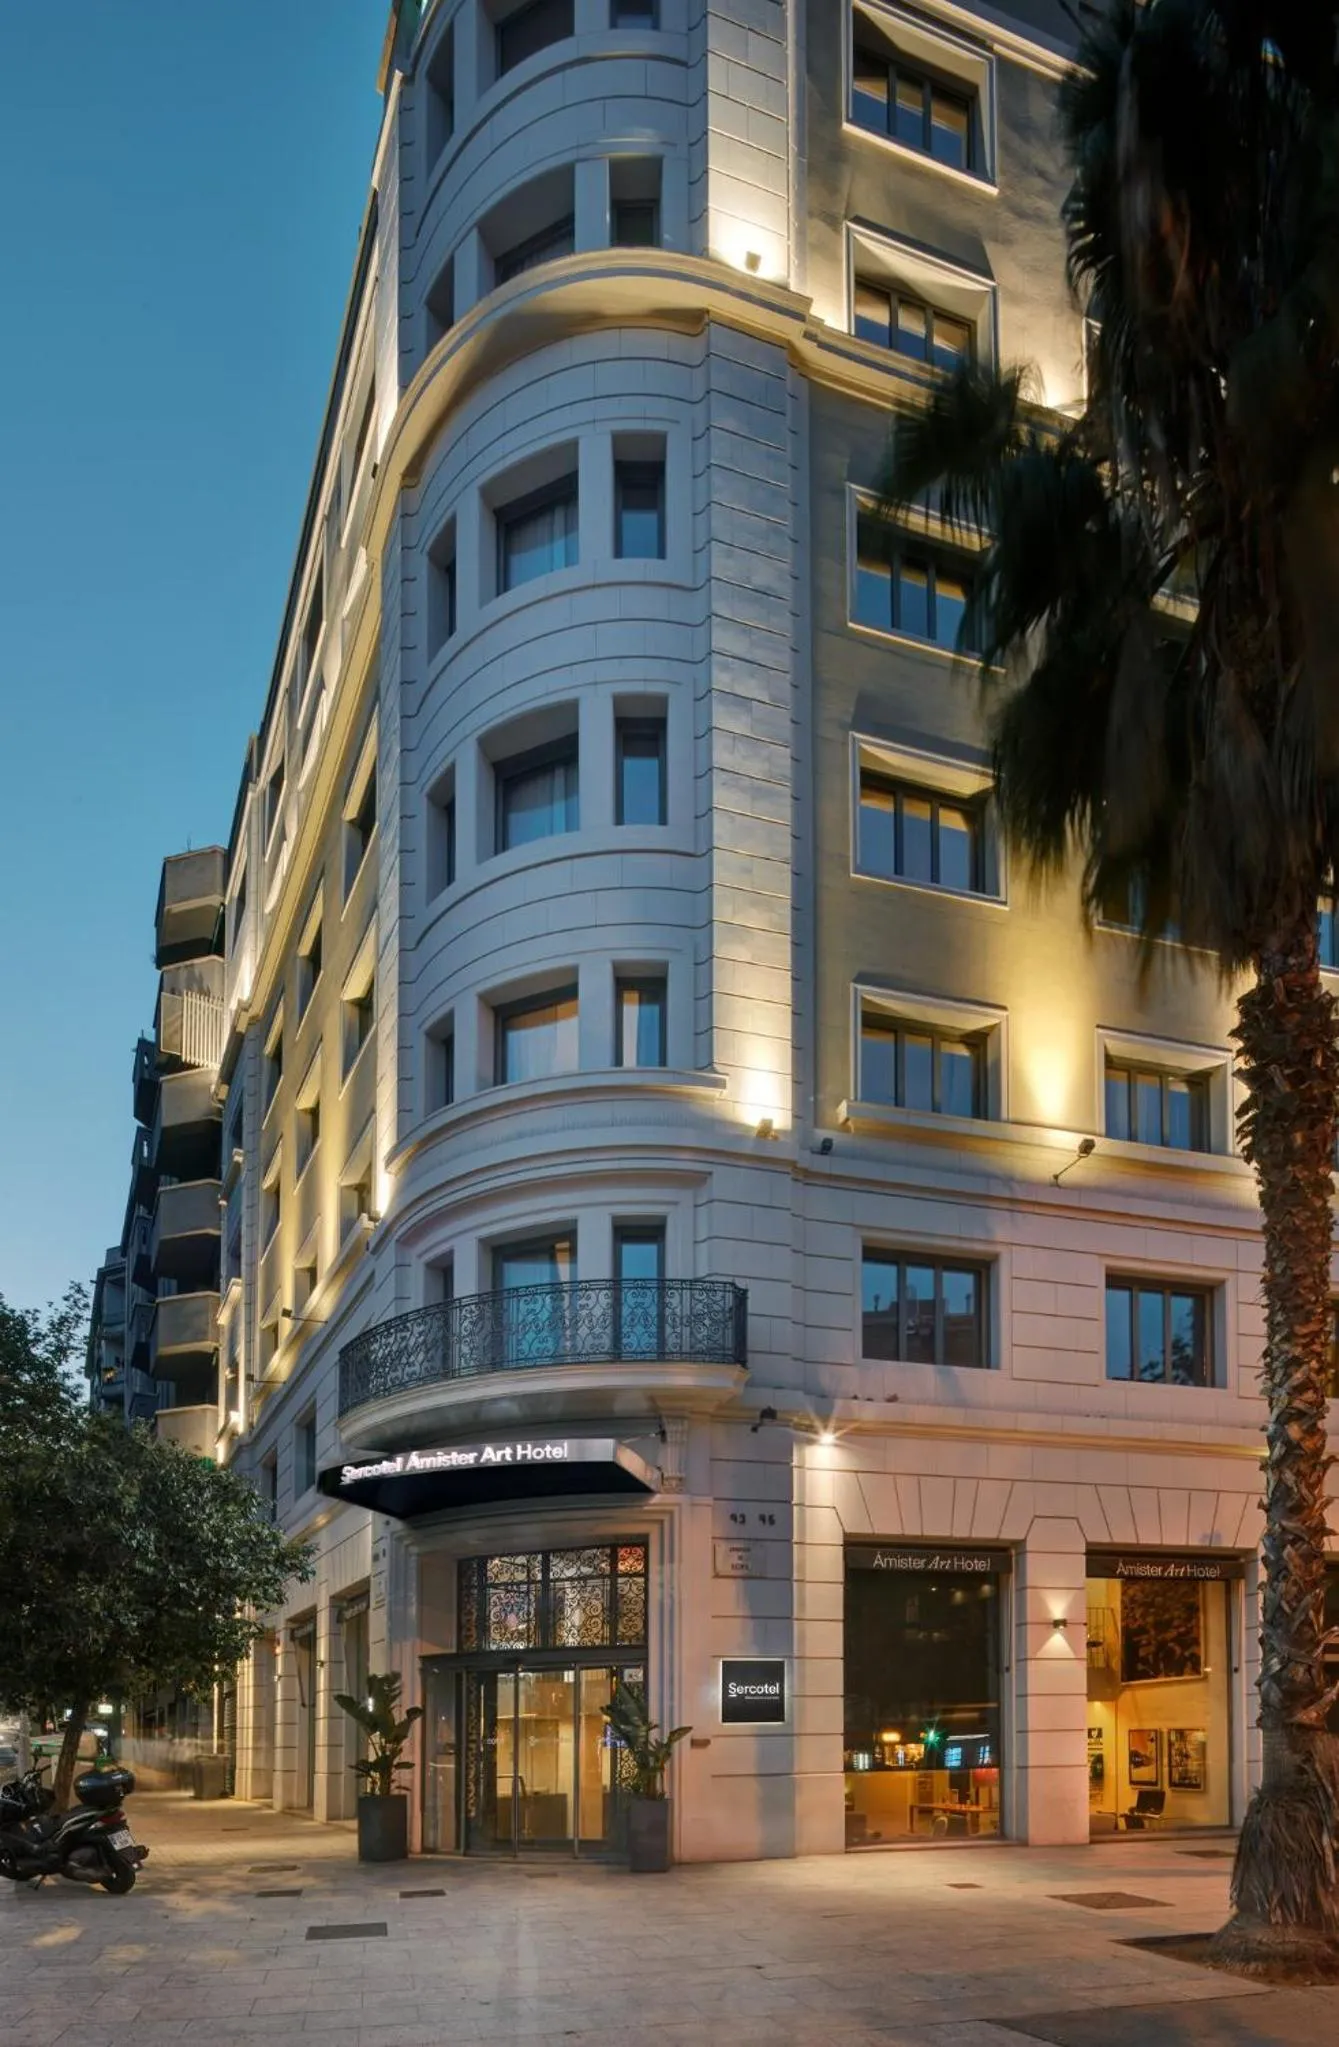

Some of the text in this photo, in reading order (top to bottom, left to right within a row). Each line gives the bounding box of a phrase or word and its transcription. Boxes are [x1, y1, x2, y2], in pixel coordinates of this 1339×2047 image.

[340, 1457, 403, 1485] Sercotel
[480, 1446, 512, 1462] Art
[516, 1442, 568, 1461] Hotel
[928, 1555, 951, 1569] Art
[953, 1556, 991, 1571] Hotel
[1164, 1563, 1186, 1577] Art
[1187, 1564, 1220, 1578] Hotel
[728, 1682, 780, 1696] Sercotel
